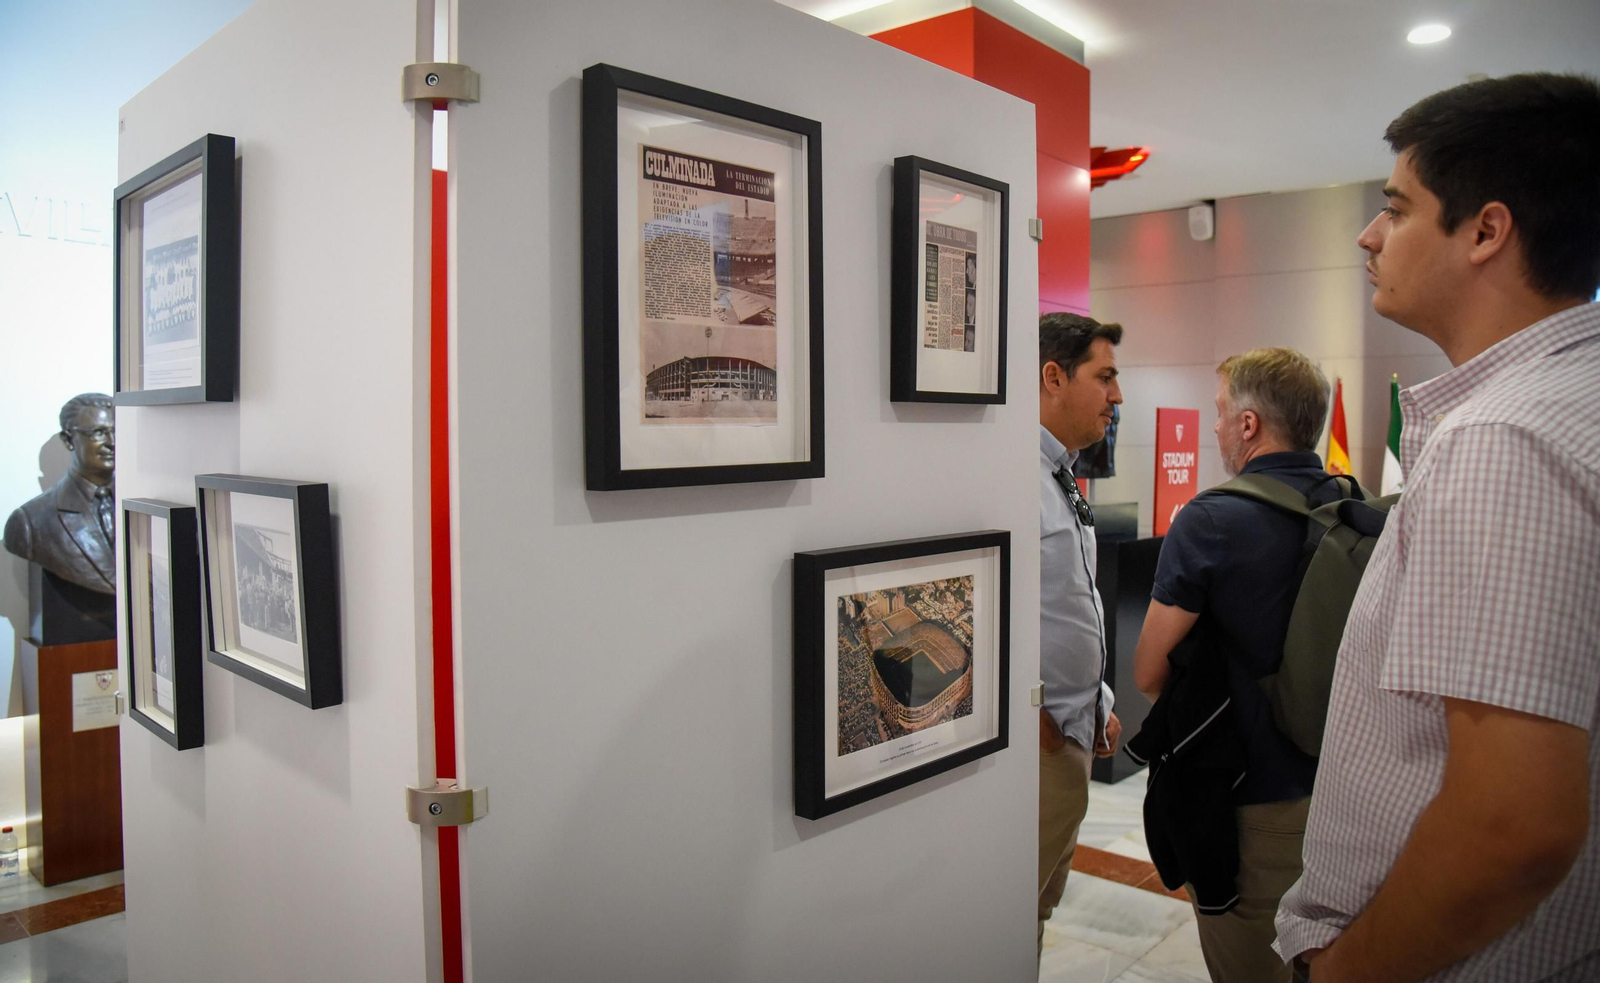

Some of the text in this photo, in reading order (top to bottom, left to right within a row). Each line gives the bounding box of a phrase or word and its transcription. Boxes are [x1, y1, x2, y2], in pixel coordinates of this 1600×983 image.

[645, 150, 716, 187] CULMINADA
[726, 169, 771, 187] LA TERMINACION
[652, 182, 660, 190] EN
[682, 187, 698, 196] NUEVA
[735, 181, 770, 196] DEL ESTADIO
[653, 198, 680, 208] ADAPTADA
[688, 203, 698, 211] LAS
[653, 205, 683, 216] EXIGENCIAS
[694, 211, 700, 219] LA
[684, 216, 691, 225] EN
[693, 218, 709, 228] COLOR
[1162, 452, 1195, 468] STADIUM
[1167, 469, 1189, 485] TOUR
